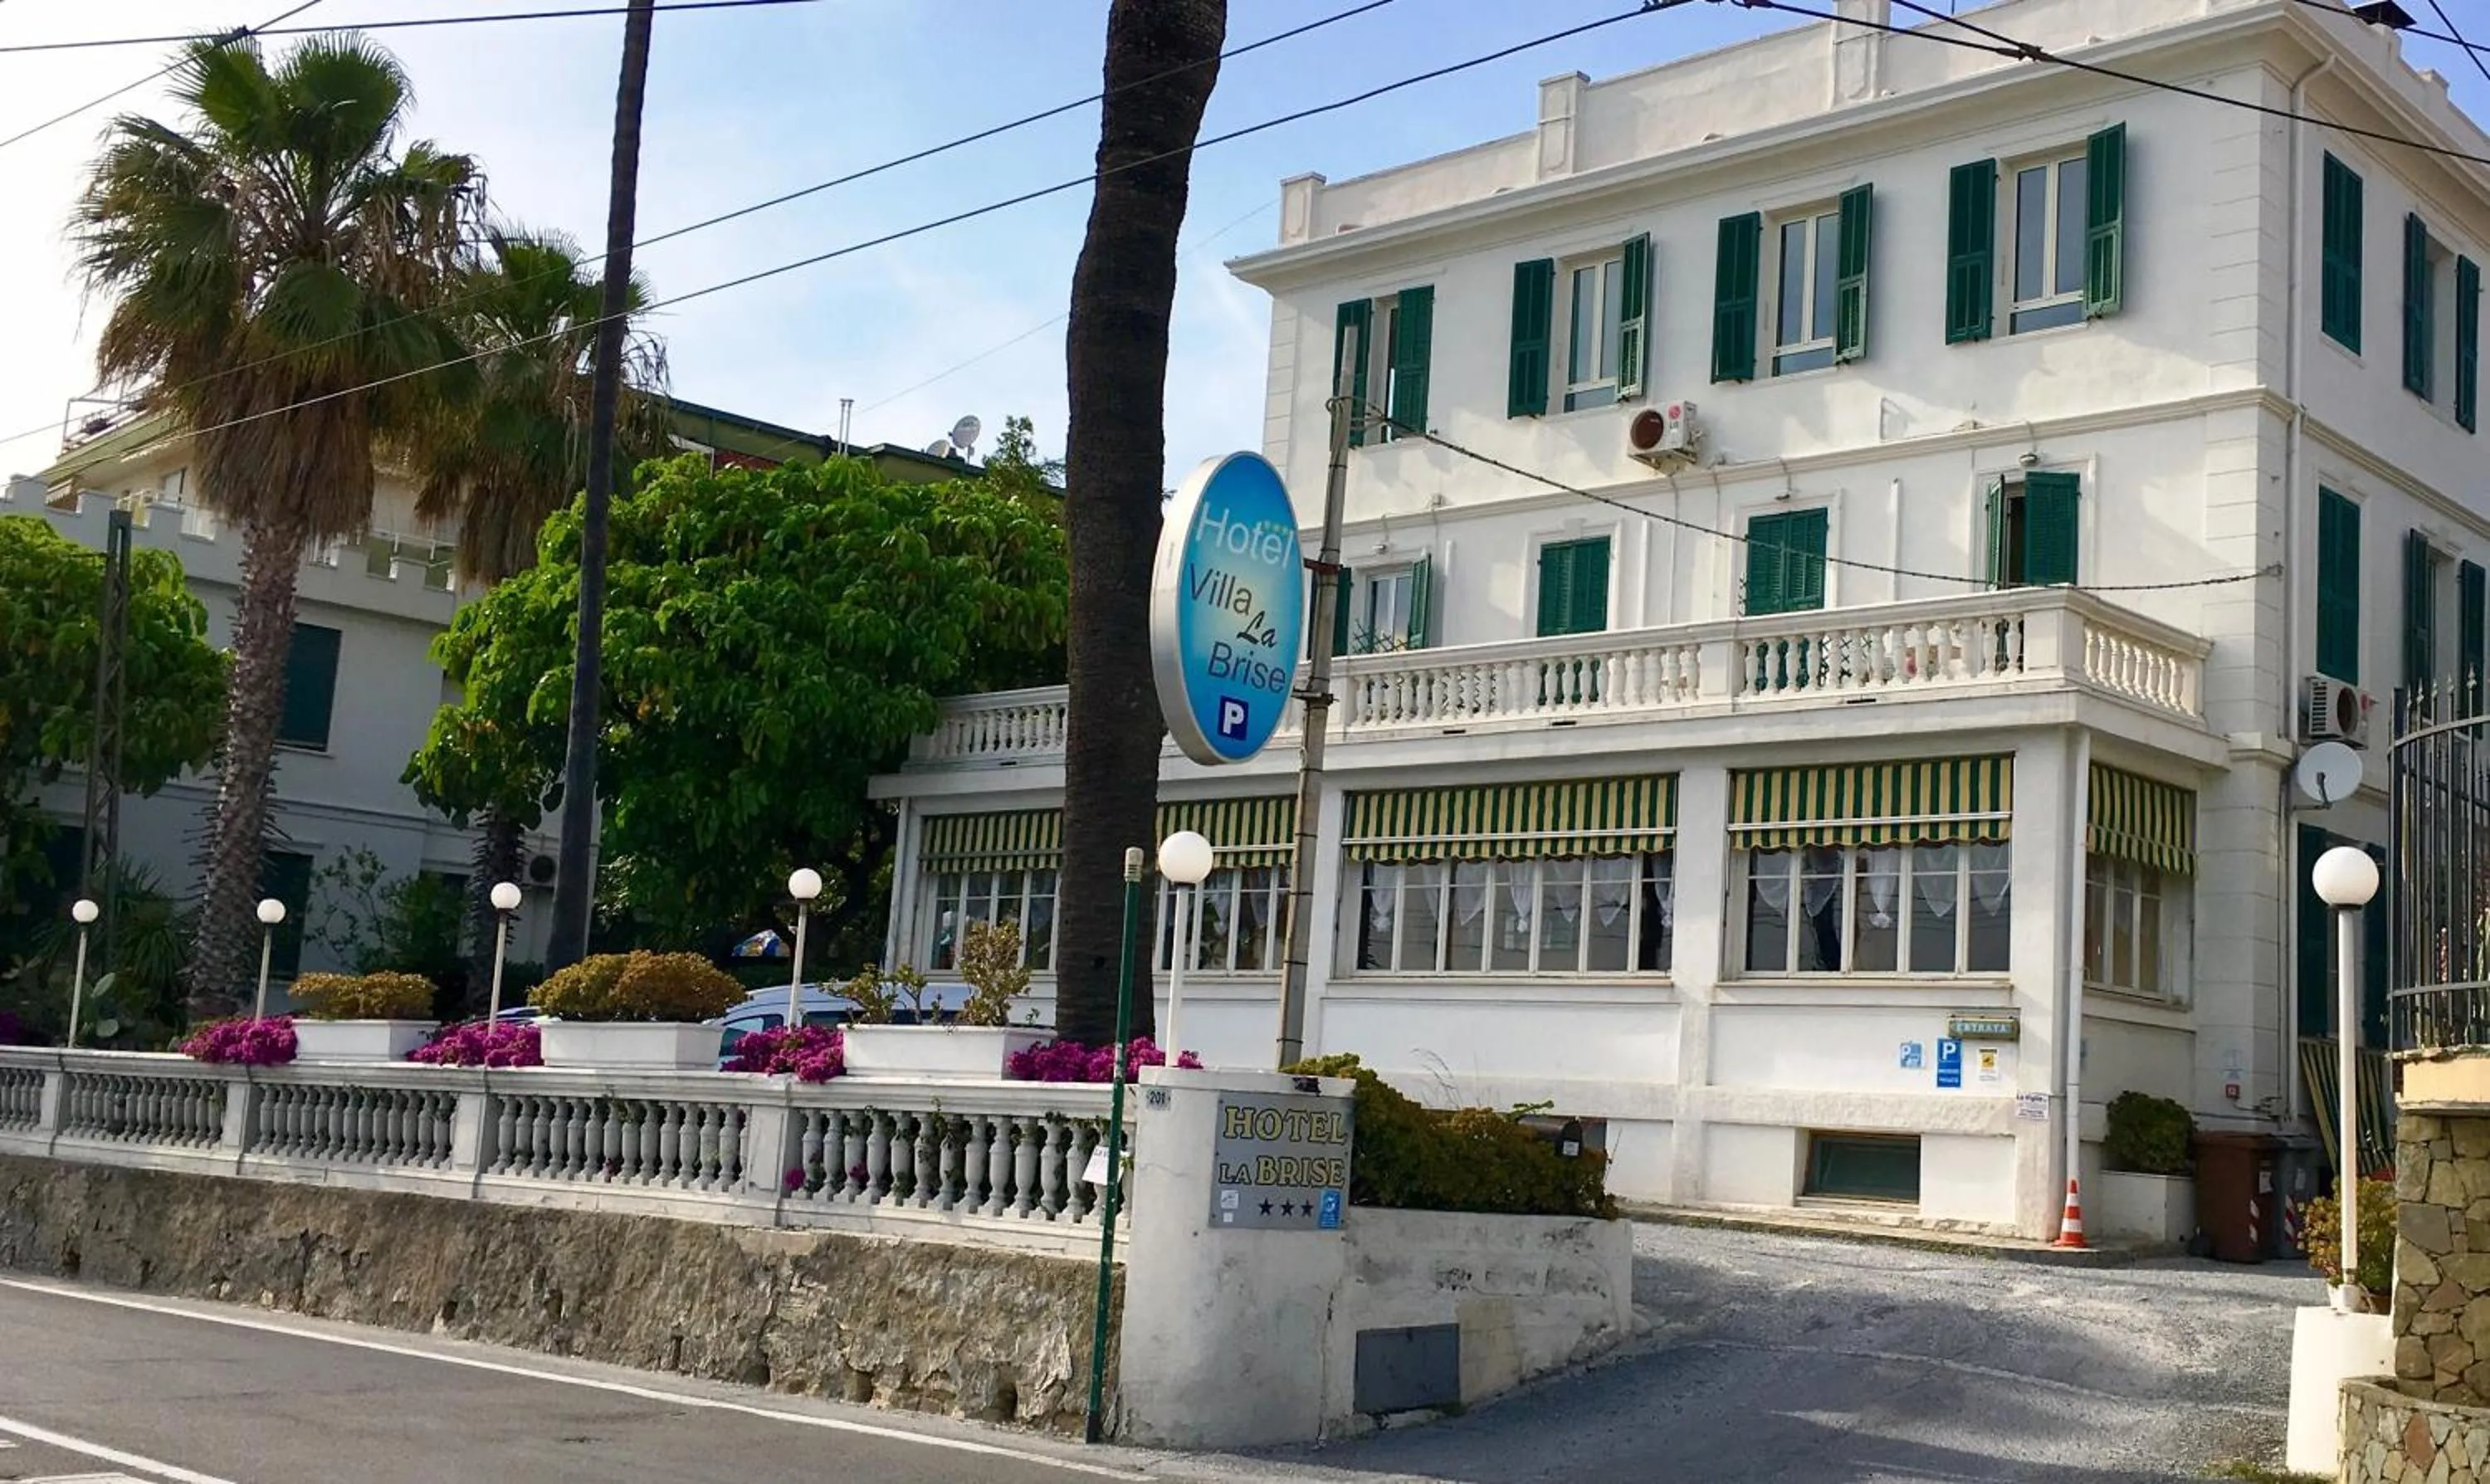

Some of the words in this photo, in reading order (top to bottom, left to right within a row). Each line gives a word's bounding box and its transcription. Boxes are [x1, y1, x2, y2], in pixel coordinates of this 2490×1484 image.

[1195, 501, 1295, 568] Hotel
[1189, 563, 1252, 615] Villa
[1237, 610, 1278, 648] La
[1208, 641, 1286, 693] Brise
[1223, 701, 1244, 734] P
[1943, 1042, 1956, 1060] P
[1223, 1106, 1348, 1145] HOTEL
[1218, 1163, 1252, 1185] LA
[1256, 1155, 1345, 1189] BRISE
